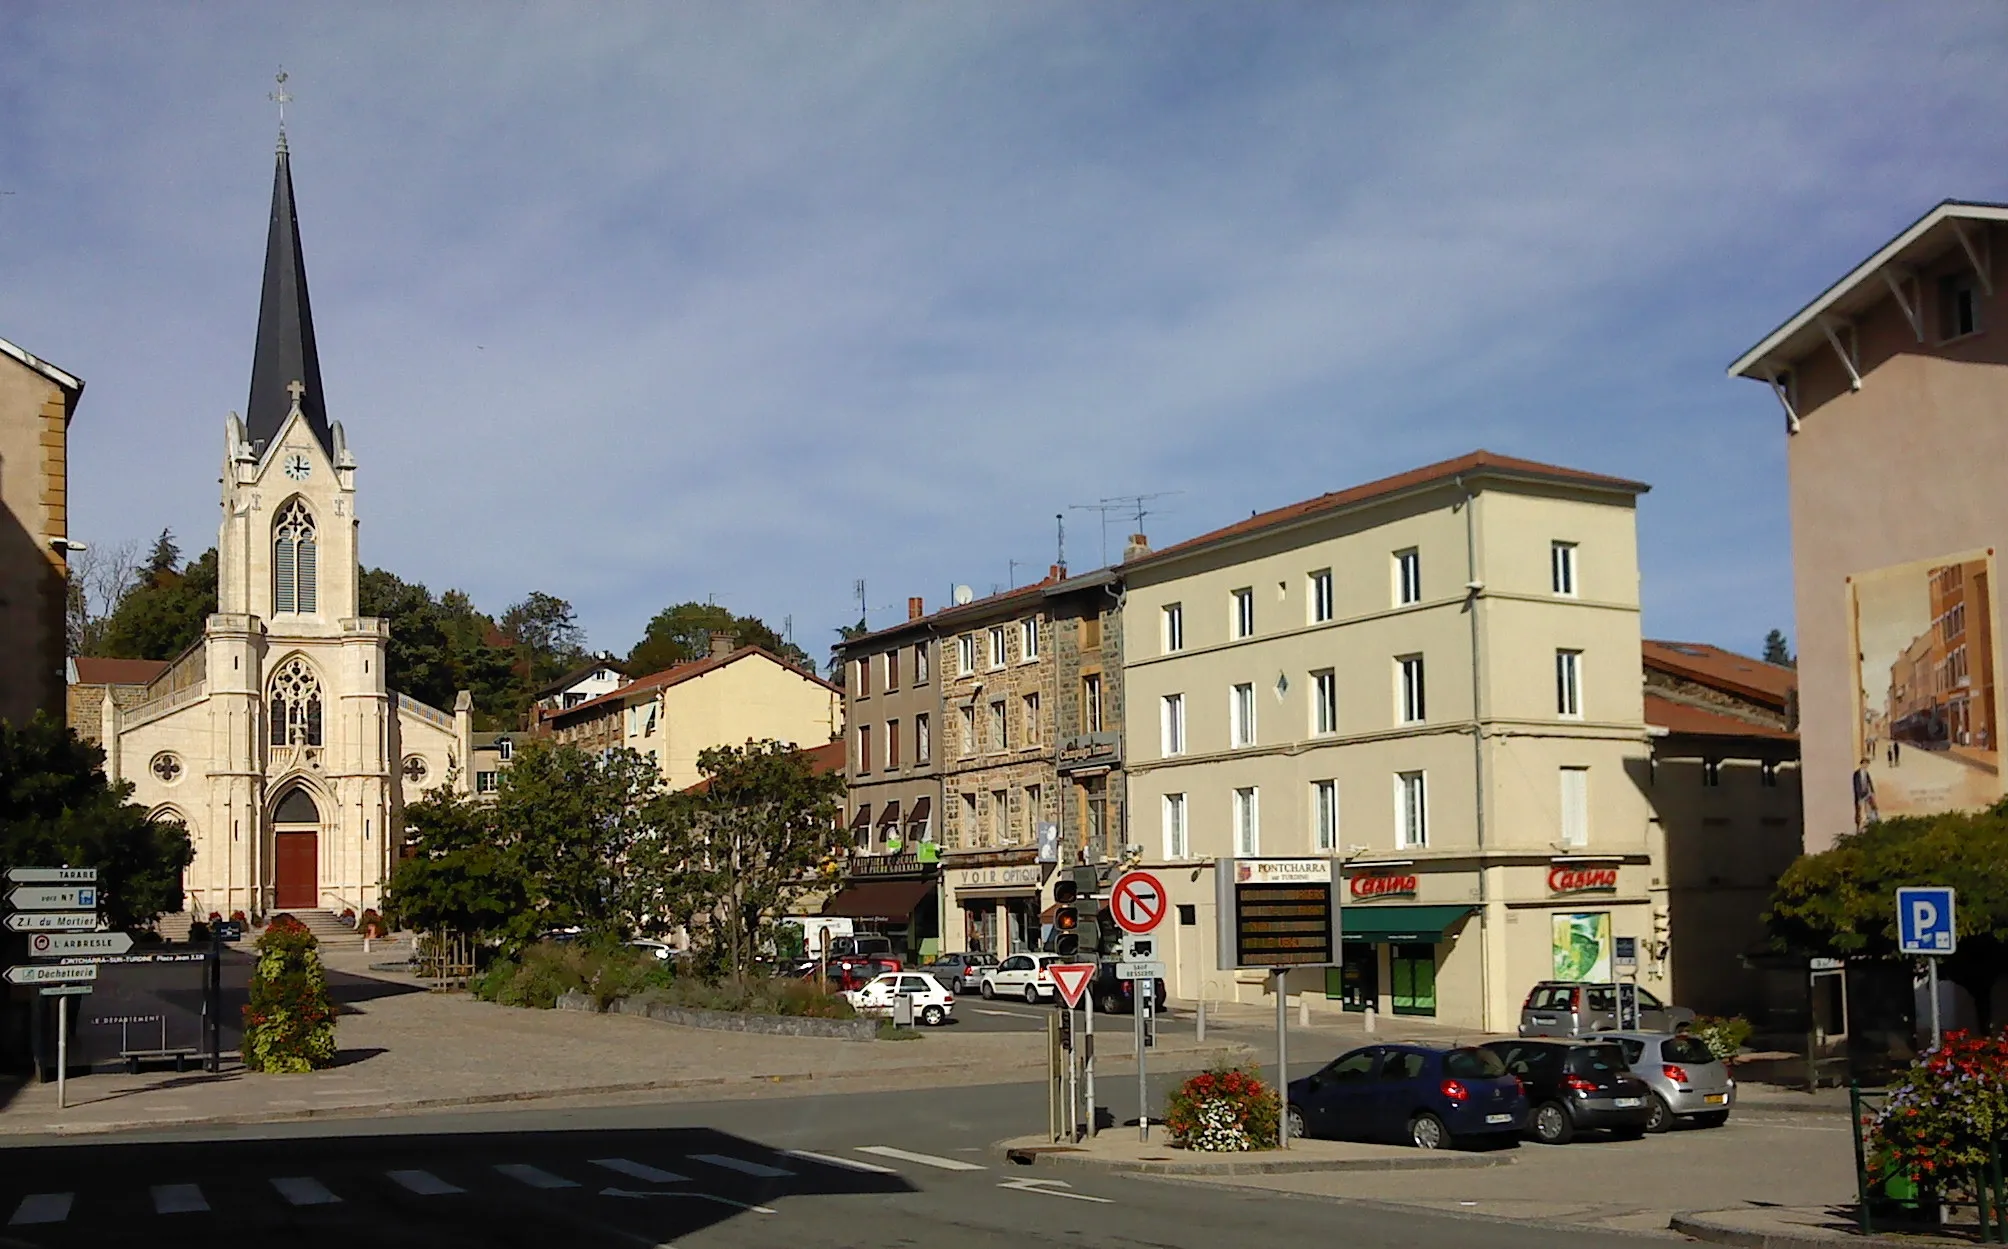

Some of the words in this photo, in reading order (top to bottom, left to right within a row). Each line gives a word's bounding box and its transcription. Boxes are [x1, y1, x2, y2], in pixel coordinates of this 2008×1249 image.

[961, 870, 996, 883] VOIR
[1258, 863, 1326, 872] PONTCHARRA
[1351, 873, 1416, 896] Casino
[1550, 867, 1617, 892] Casino
[39, 917, 51, 926] du
[57, 917, 94, 925] Mortier
[1912, 901, 1937, 940] P
